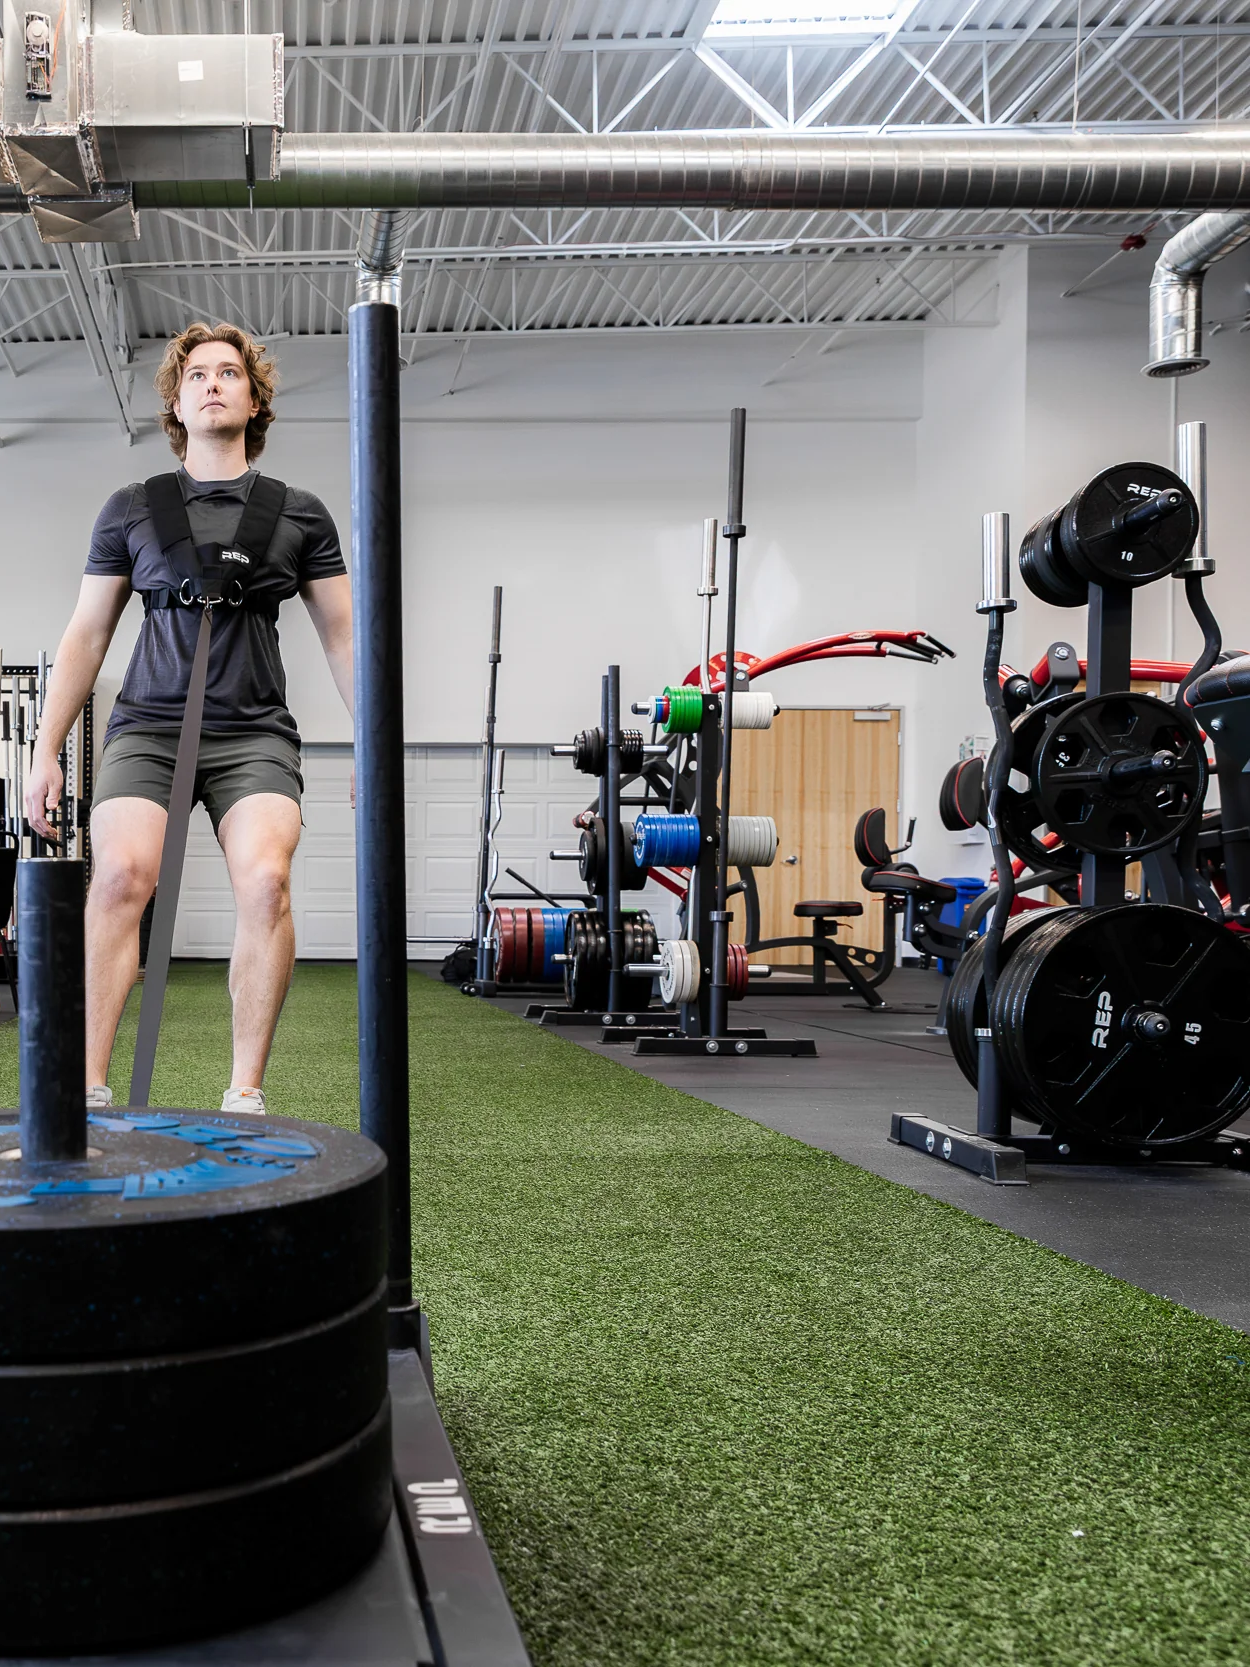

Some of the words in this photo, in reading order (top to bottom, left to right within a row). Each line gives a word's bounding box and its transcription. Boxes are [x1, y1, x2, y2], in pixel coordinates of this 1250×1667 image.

[1127, 483, 1162, 498] REP
[221, 550, 250, 564] REP
[1121, 550, 1134, 562] 10
[1091, 991, 1113, 1049] REP
[1184, 1022, 1202, 1045] 45
[406, 1478, 472, 1534] REP
